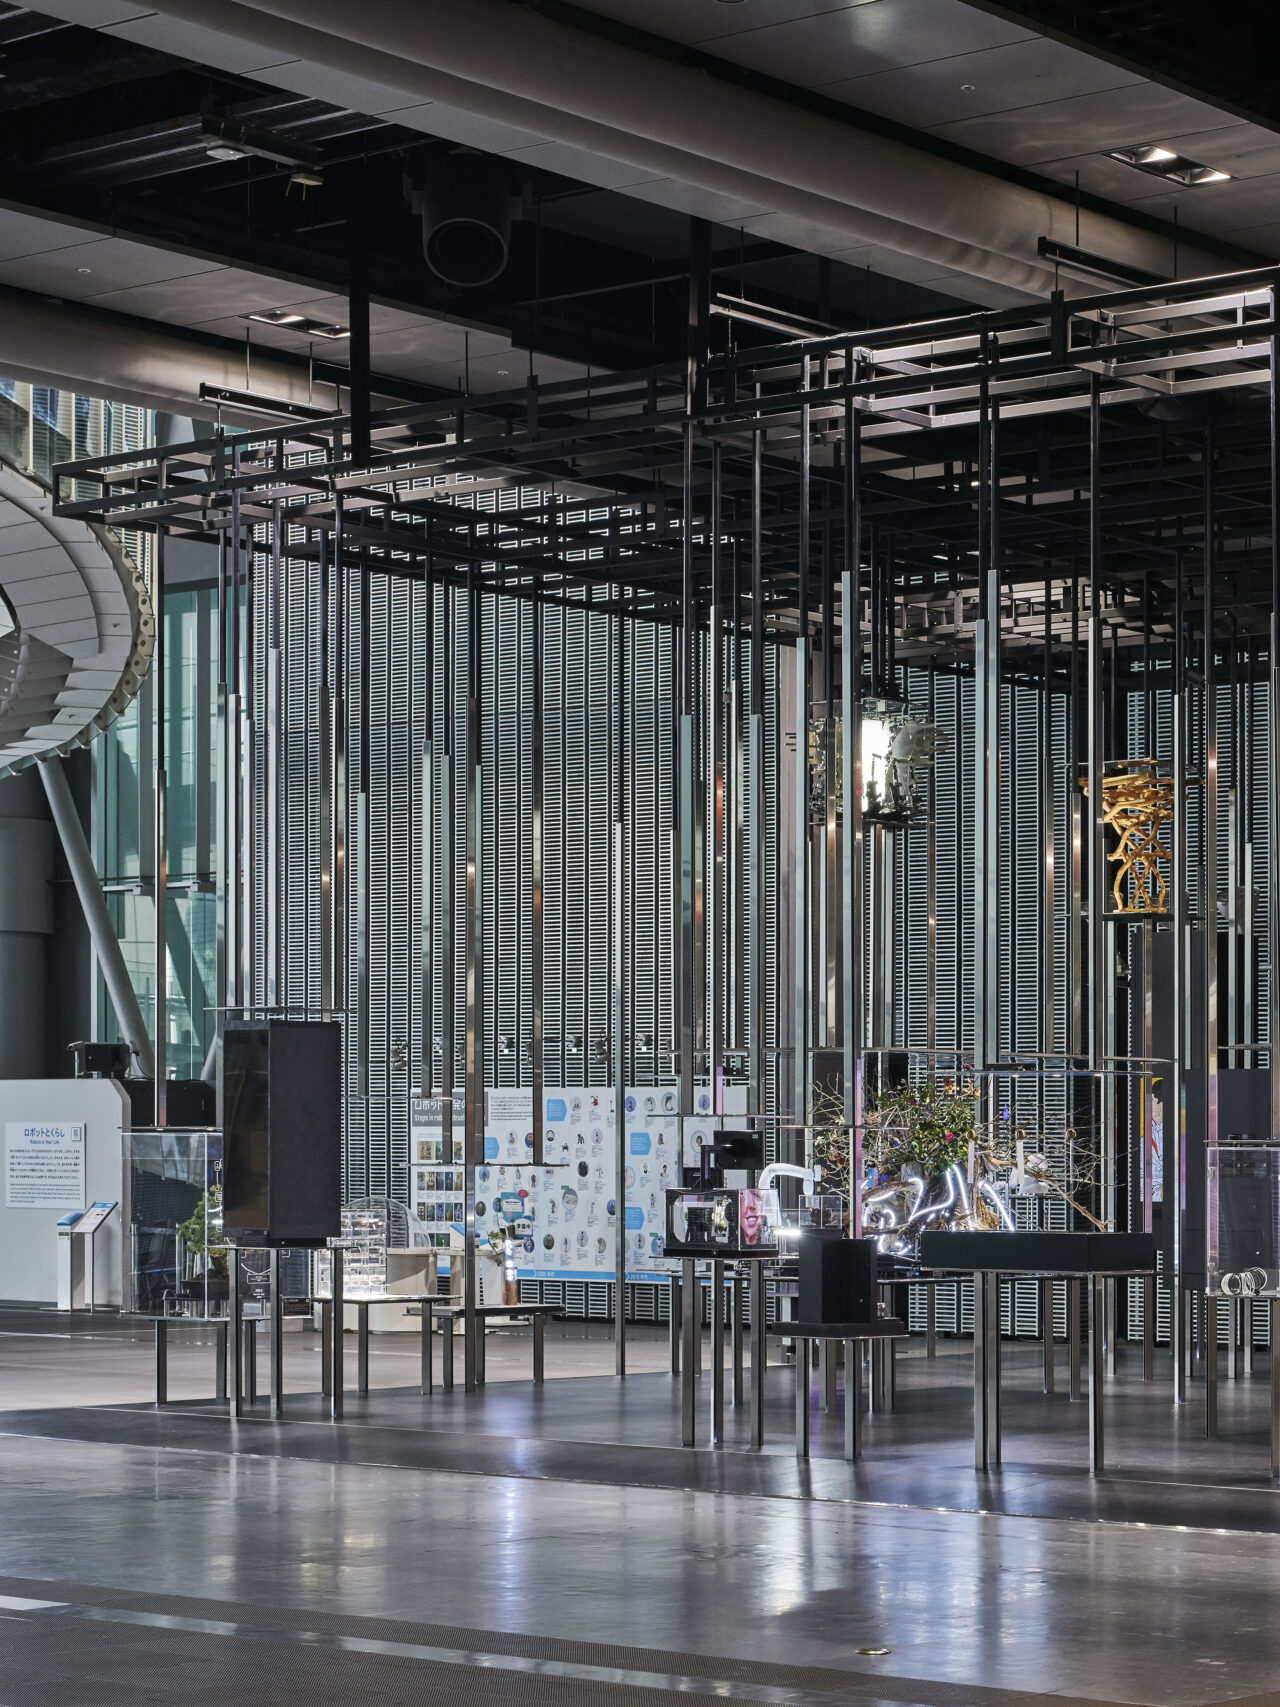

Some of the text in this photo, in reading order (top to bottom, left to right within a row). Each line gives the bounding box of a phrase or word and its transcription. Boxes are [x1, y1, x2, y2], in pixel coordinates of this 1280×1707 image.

[24, 1128, 64, 1137] ロボットとくらし
